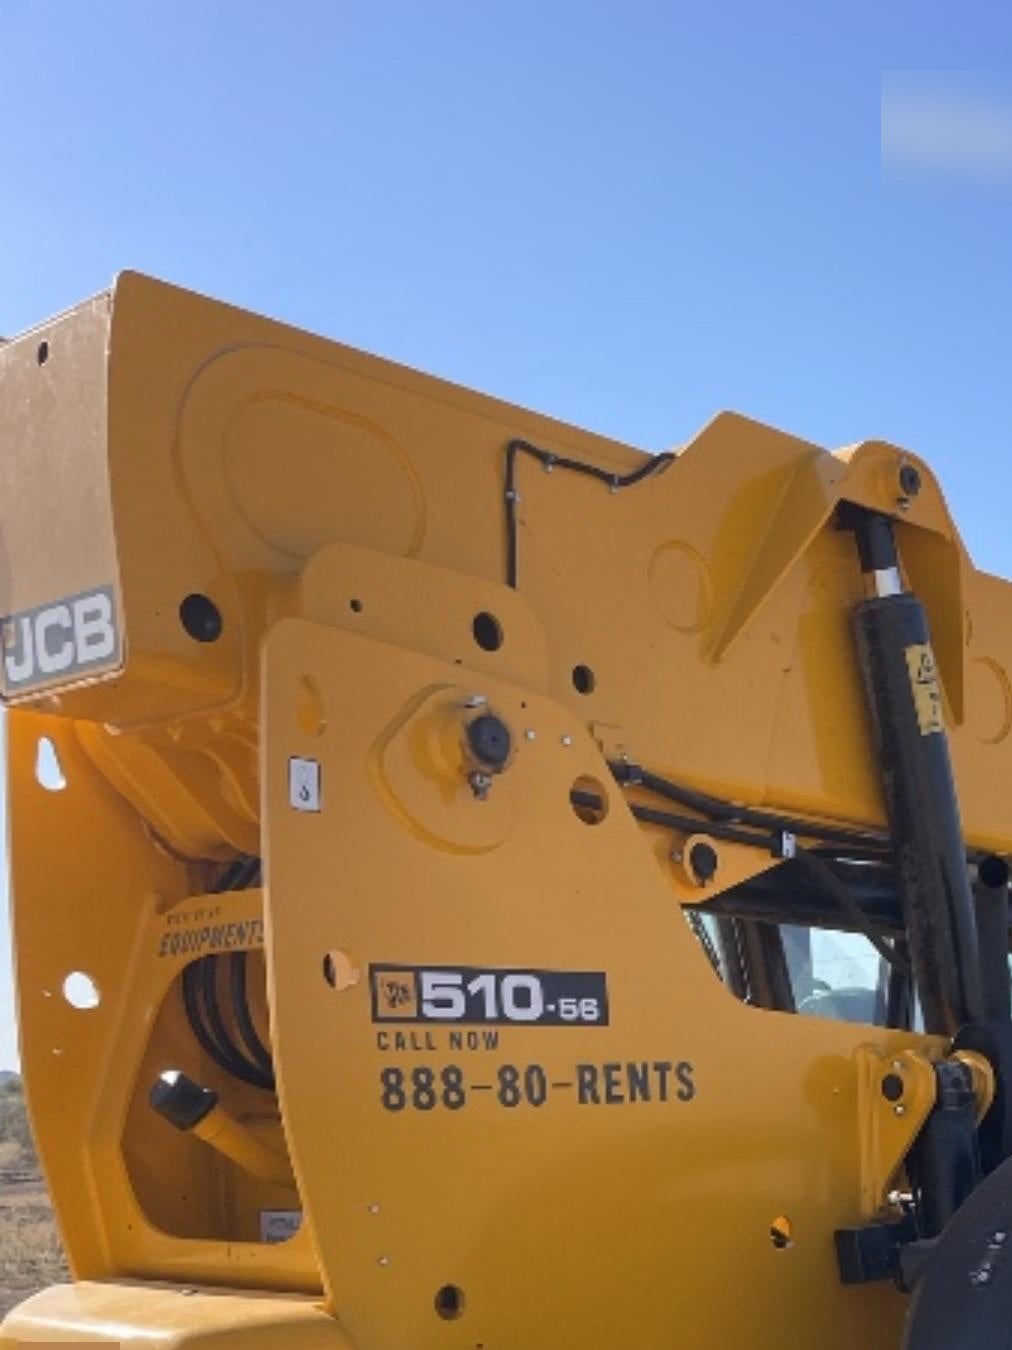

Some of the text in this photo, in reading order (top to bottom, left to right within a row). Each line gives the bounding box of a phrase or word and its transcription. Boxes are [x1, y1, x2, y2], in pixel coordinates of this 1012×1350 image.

[4, 592, 115, 683] JCB
[376, 1030, 500, 1051] CALL NOW
[380, 1060, 696, 1112] 888-80-RENTS
